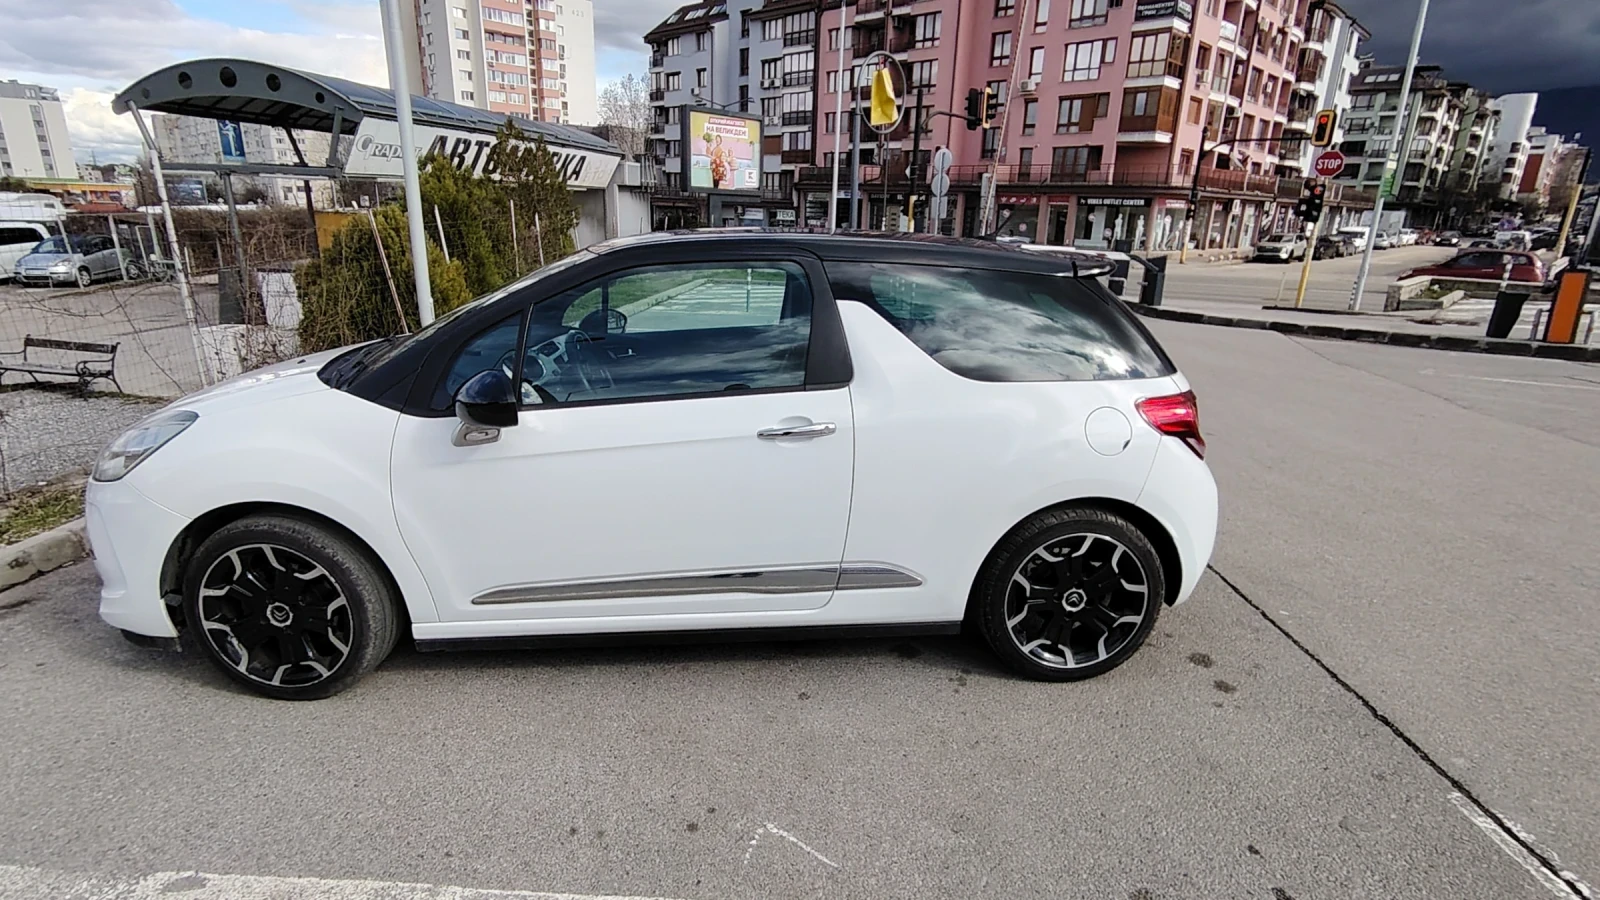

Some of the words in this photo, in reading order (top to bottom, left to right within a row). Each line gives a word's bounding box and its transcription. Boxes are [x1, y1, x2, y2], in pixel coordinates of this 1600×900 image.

[356, 134, 423, 162] GRAPT
[423, 134, 587, 183] АВТОКА
[1316, 158, 1342, 170] STOP
[777, 210, 794, 218] ТЕКА
